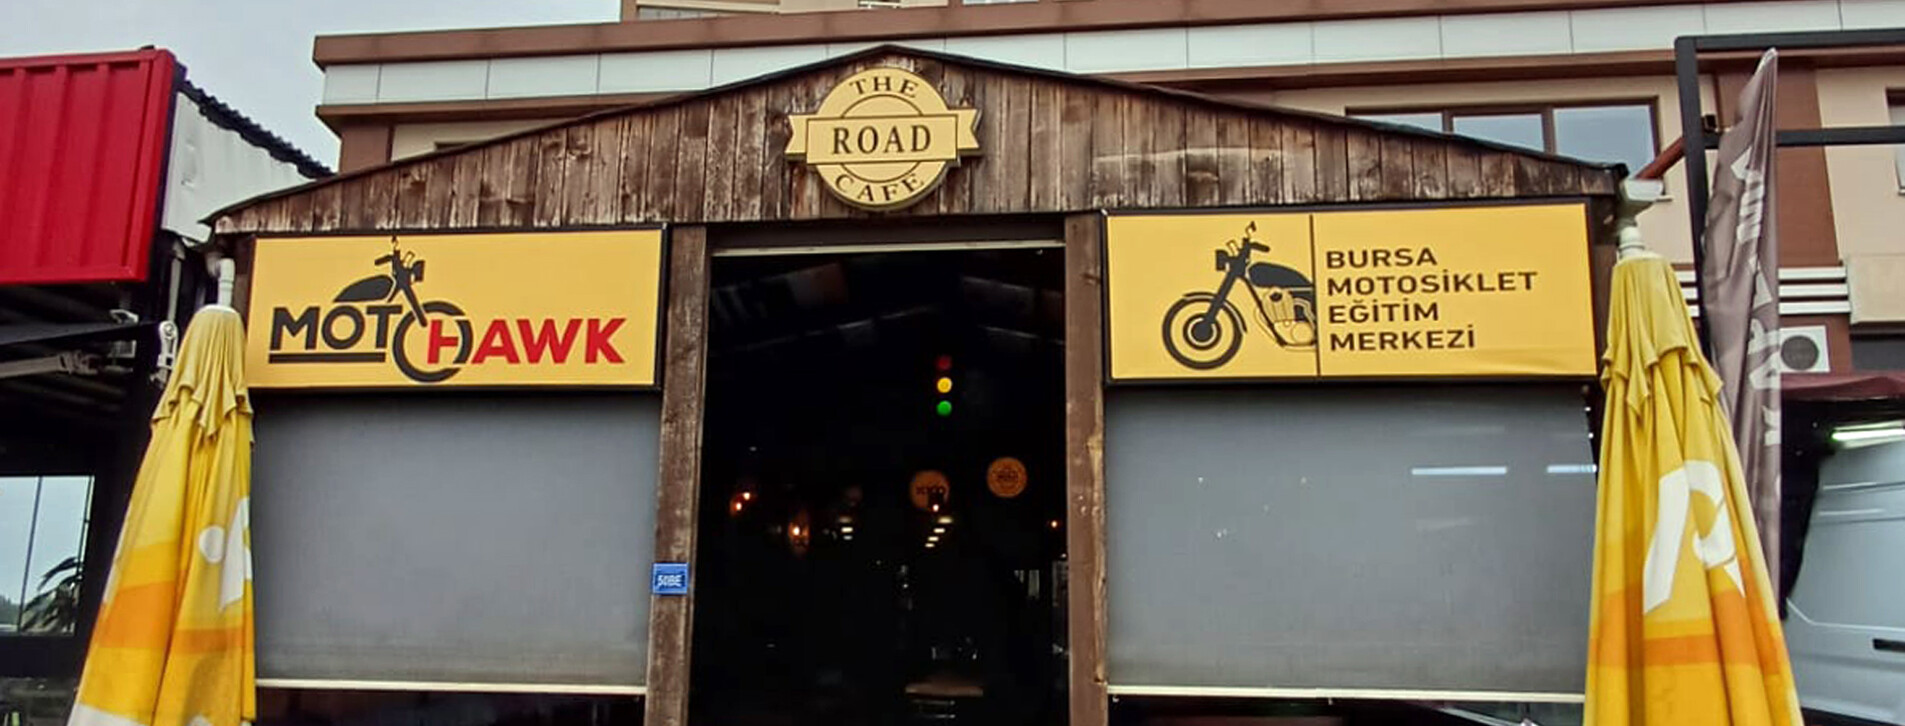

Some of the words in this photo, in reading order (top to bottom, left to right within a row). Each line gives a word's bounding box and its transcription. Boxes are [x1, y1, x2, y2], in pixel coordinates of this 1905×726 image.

[849, 76, 919, 98] THE
[832, 125, 931, 155] ROAD
[834, 173, 924, 202] CAFE
[1326, 247, 1438, 269] BURSA
[1327, 269, 1538, 296] MOTOSİKLET
[1328, 298, 1439, 325] EĞİTİM
[1330, 325, 1476, 352] MERKEZİ
